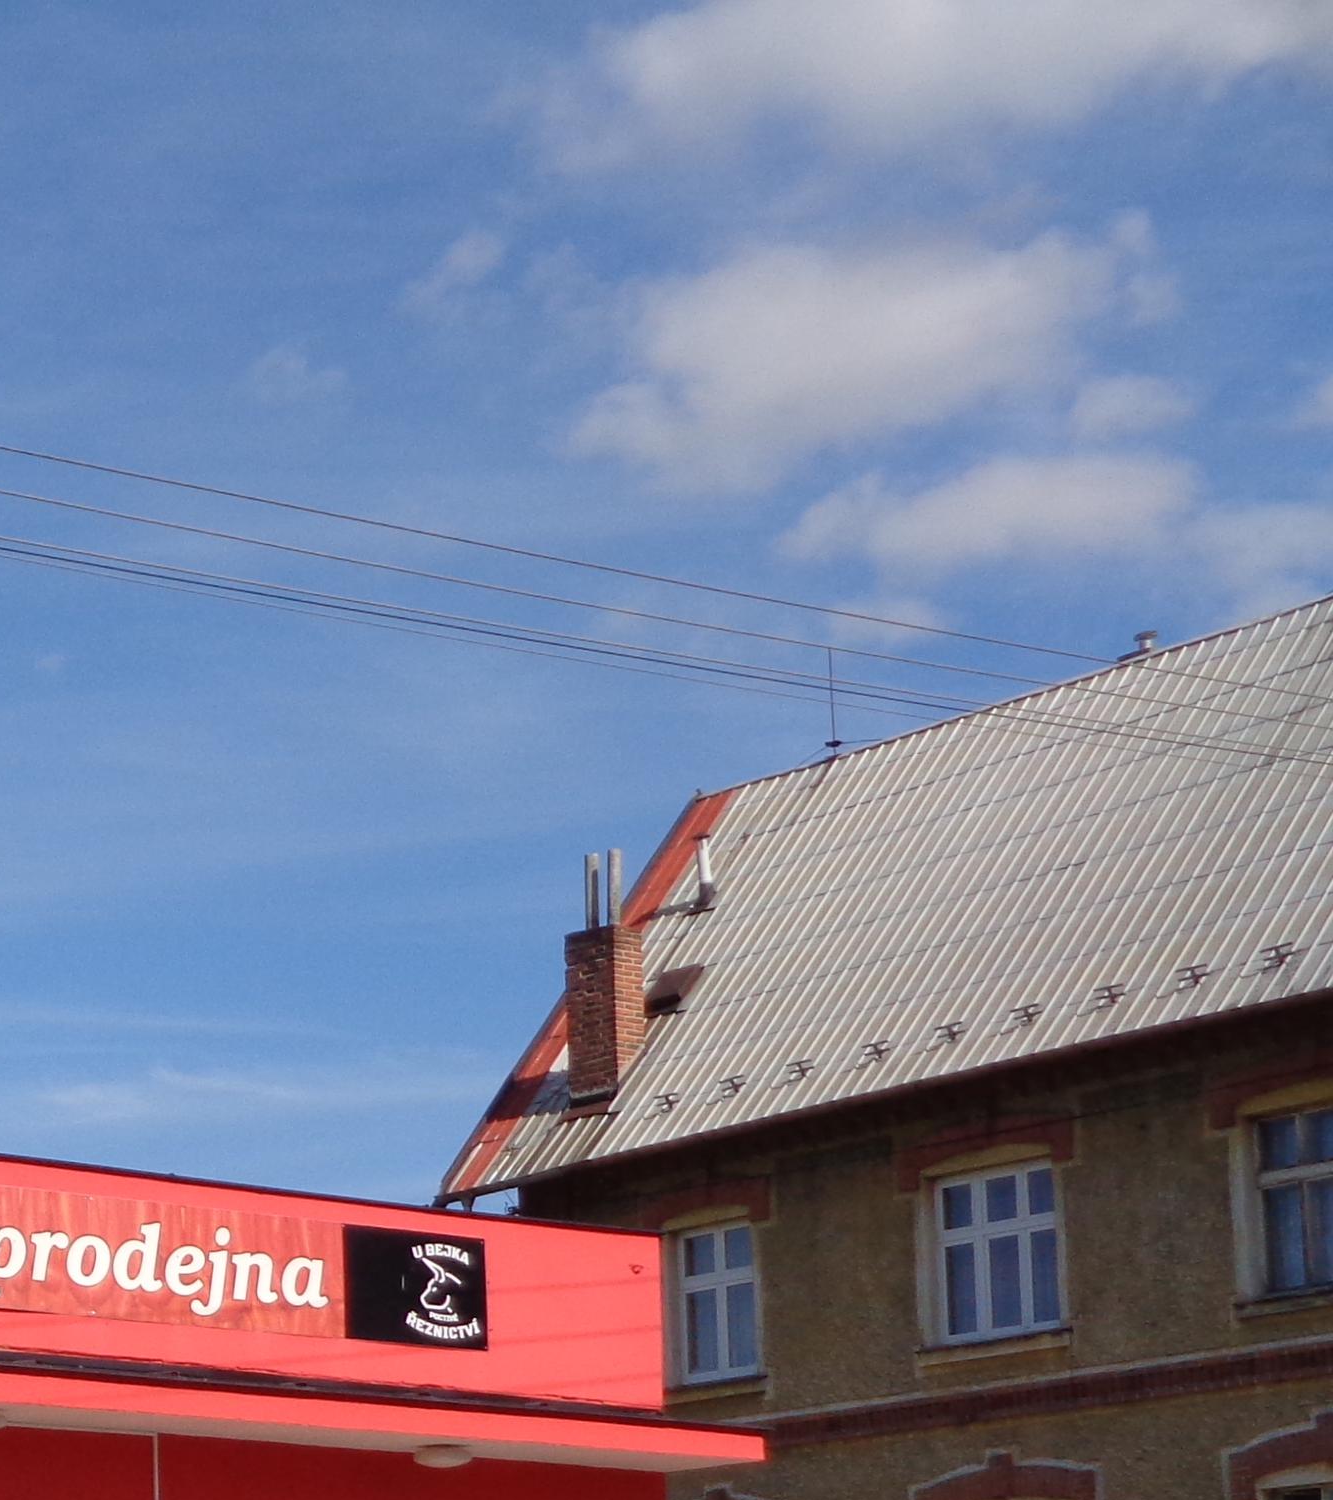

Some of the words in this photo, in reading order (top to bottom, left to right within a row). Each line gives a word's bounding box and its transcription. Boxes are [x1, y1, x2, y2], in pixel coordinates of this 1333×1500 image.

[412, 1245, 423, 1259] U
[424, 1243, 469, 1265] BEJKA
[405, 1311, 481, 1339] ŘEZNICTVÍ
